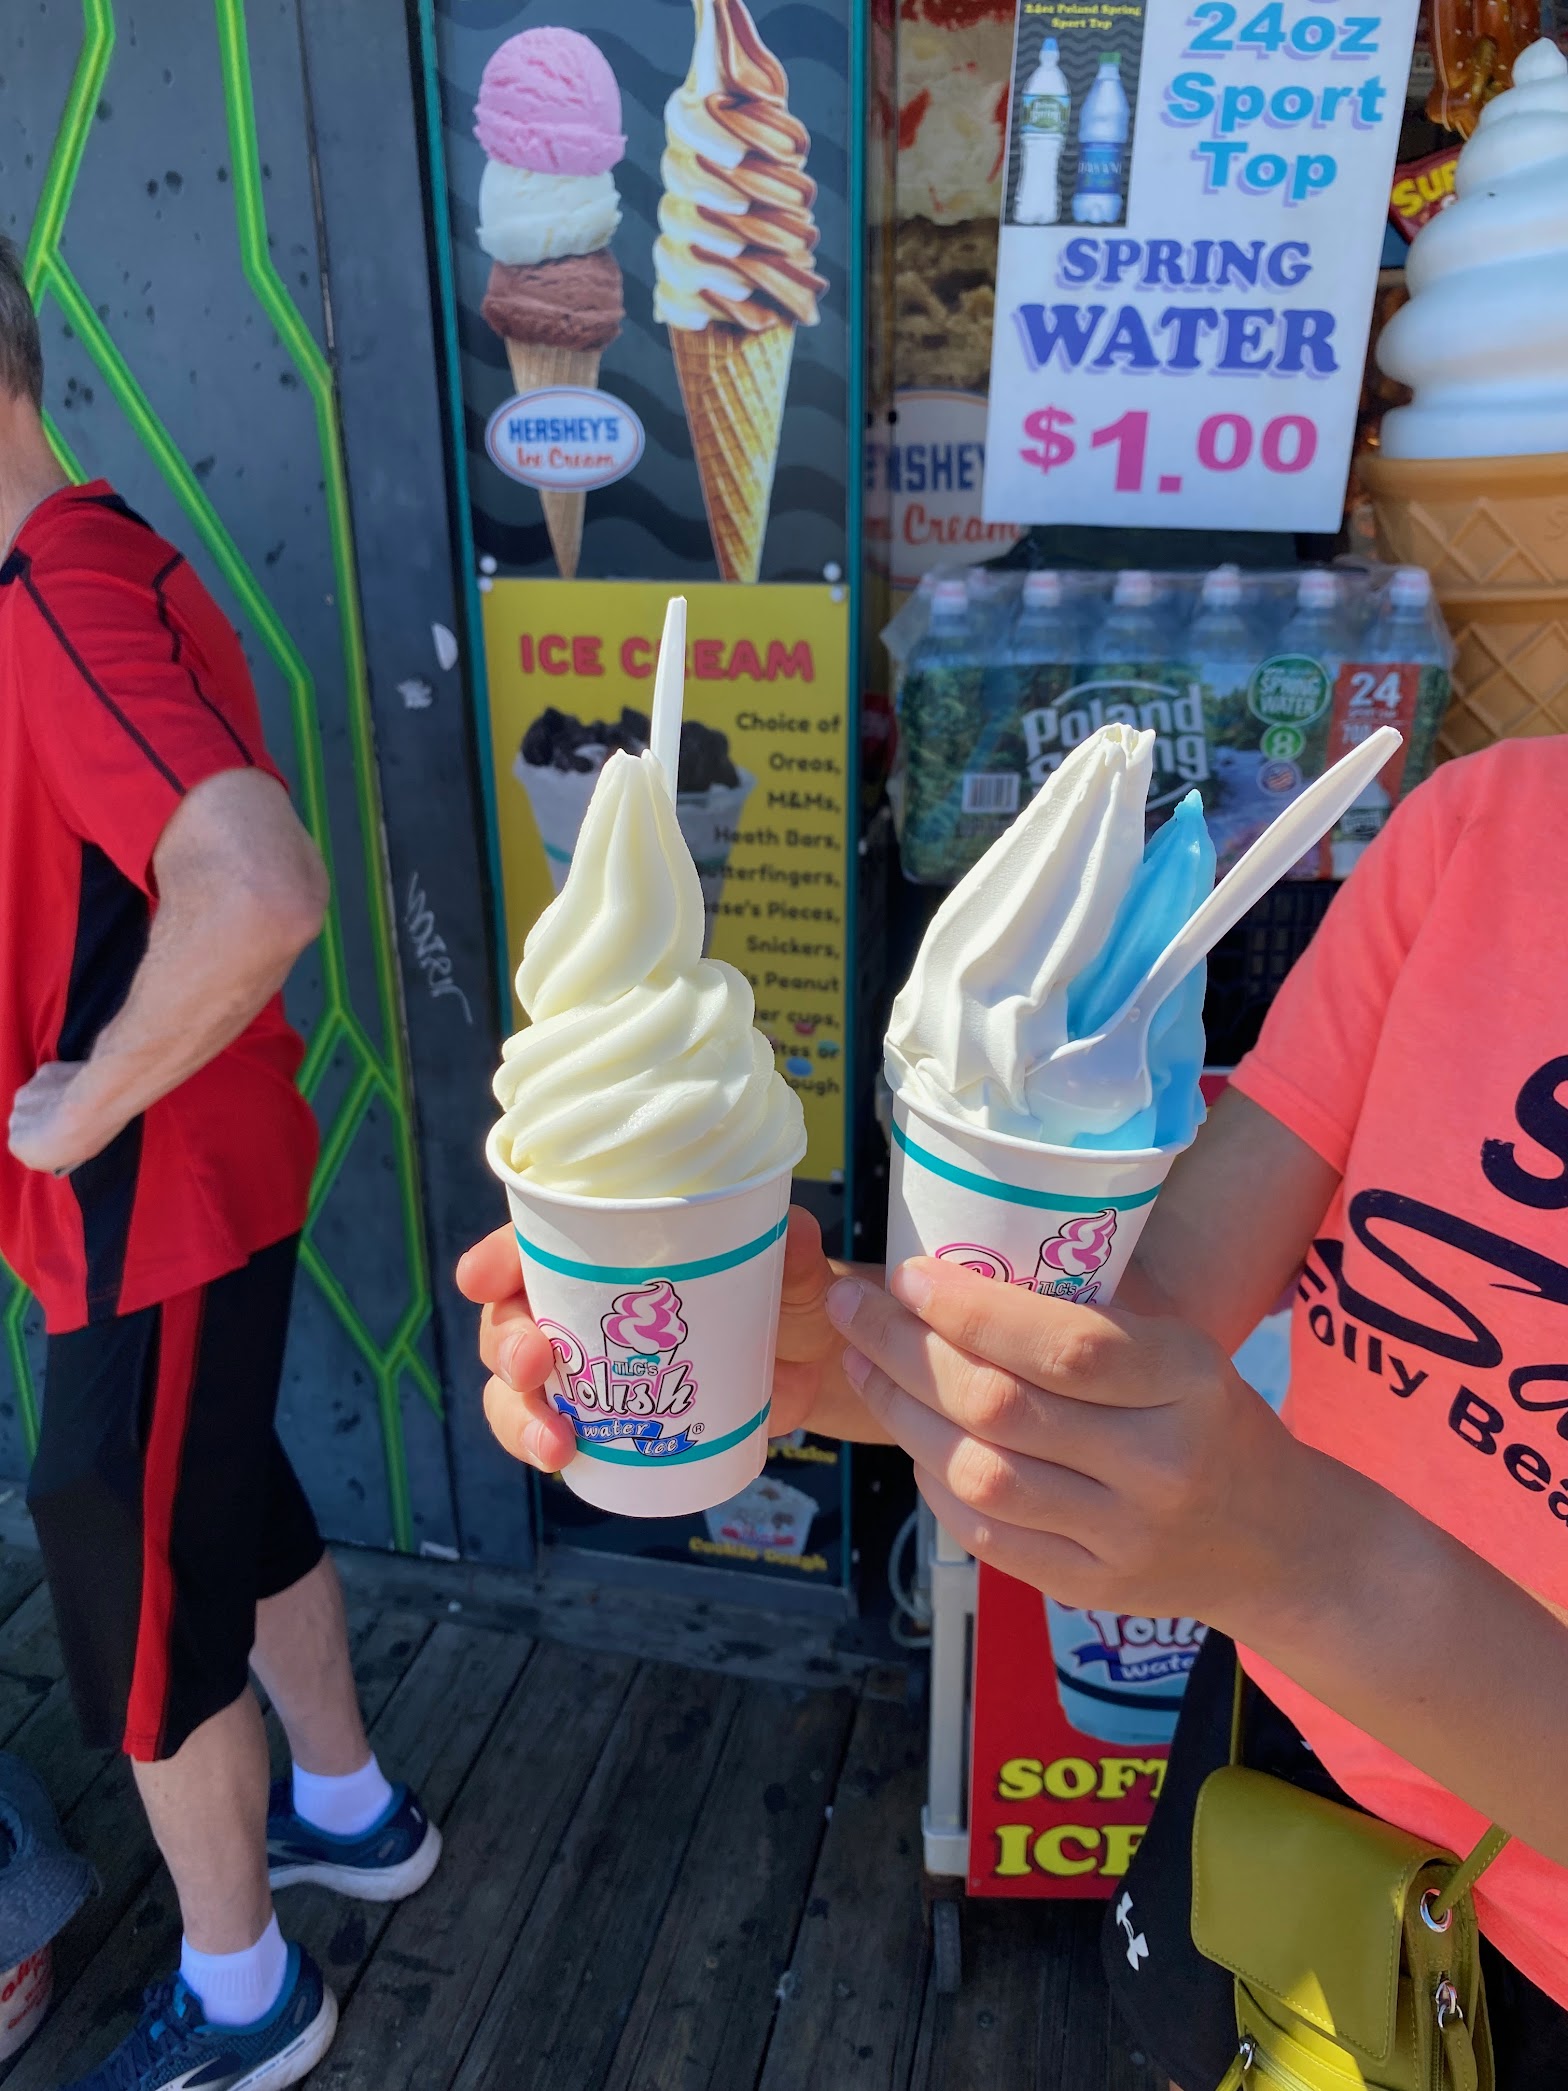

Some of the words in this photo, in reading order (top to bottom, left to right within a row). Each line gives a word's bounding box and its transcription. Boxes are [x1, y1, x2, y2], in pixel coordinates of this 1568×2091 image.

[1184, 1, 1382, 56] 24oz
[1163, 72, 1387, 136] Sport
[1195, 140, 1338, 205] Top
[1059, 237, 1313, 290] SPRING
[1013, 304, 1339, 375] WATER
[508, 417, 621, 444] HERSHEY'S
[1018, 405, 1319, 494] $1.00
[516, 445, 542, 468] Ice
[548, 446, 615, 469] Cream
[519, 633, 605, 676] ICE
[619, 636, 815, 684] CEAM
[1350, 671, 1402, 709] 24
[736, 712, 811, 734] Choice
[817, 714, 841, 735] of
[713, 826, 780, 845] Heath
[1037, 1280, 1077, 1296] TLC's
[537, 1319, 698, 1418] Polish
[613, 1359, 659, 1378] TLC's
[583, 1420, 649, 1438] water
[1120, 1655, 1194, 1682] wate
